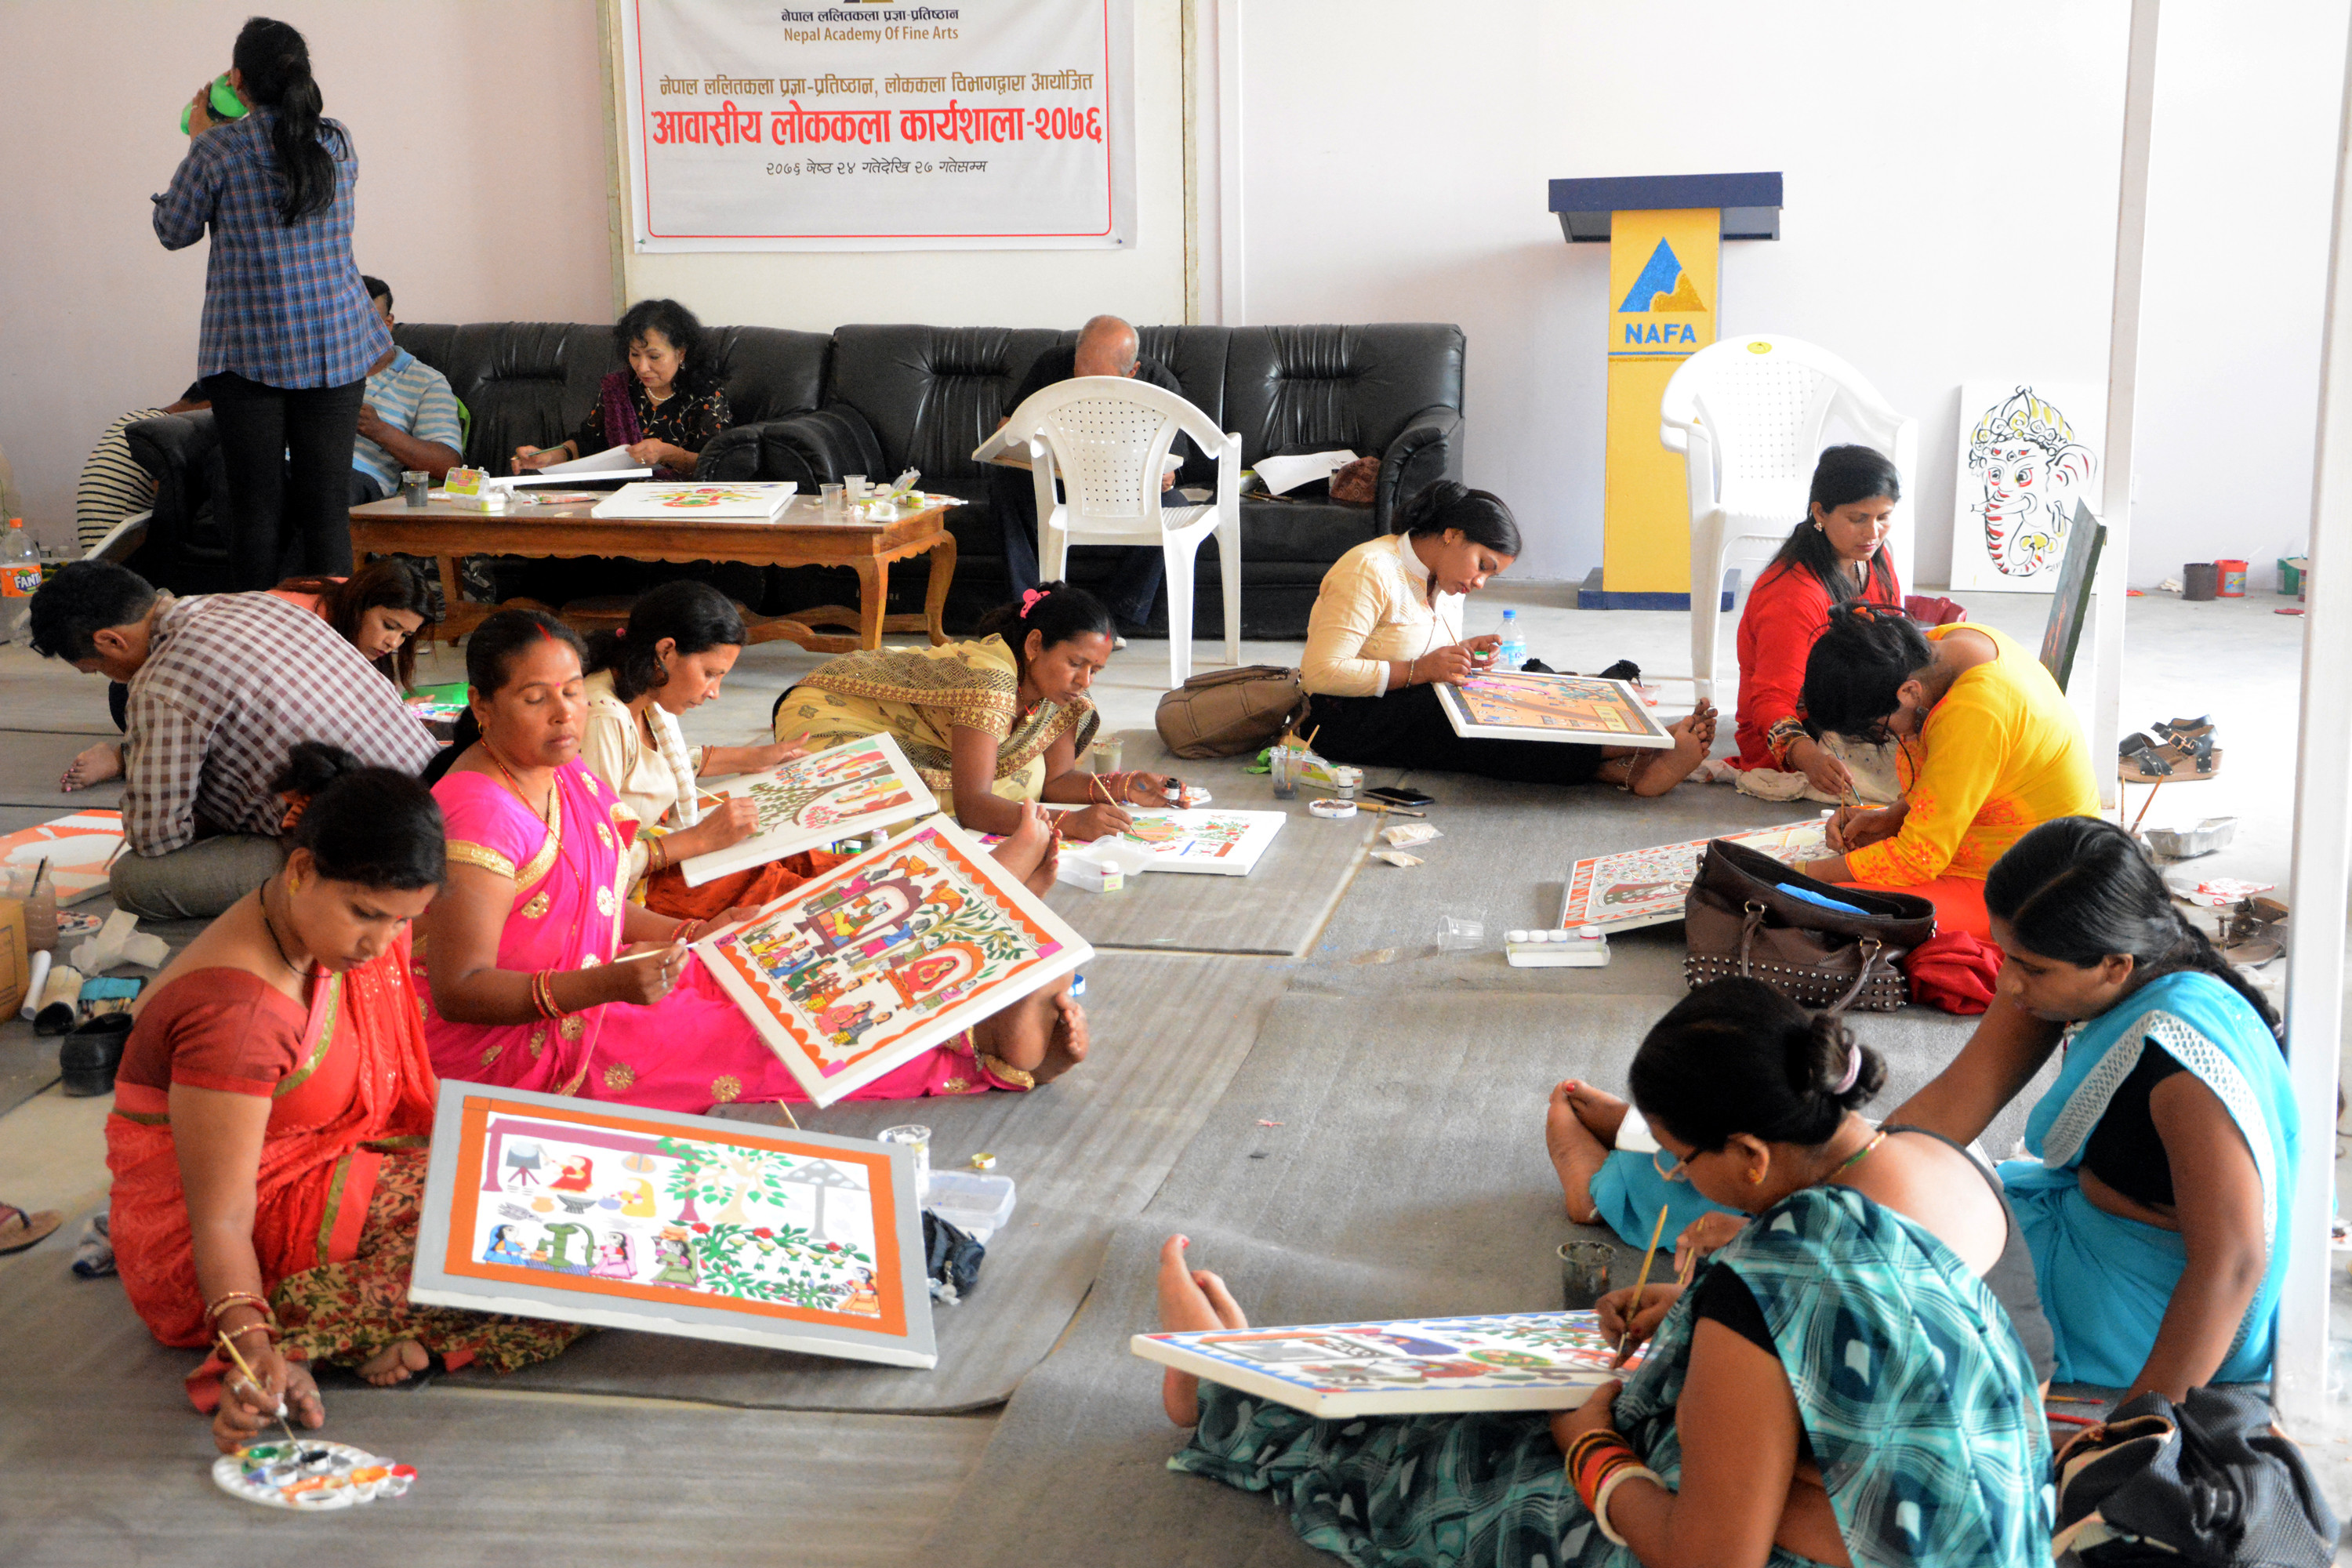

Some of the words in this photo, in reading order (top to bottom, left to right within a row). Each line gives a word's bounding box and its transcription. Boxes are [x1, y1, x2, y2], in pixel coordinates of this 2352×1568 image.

[782, 9, 814, 22] नेपाल
[818, 8, 879, 22] ललितकला
[784, 27, 820, 44] Nepal
[825, 27, 881, 44] Academy
[885, 26, 899, 40] Of
[903, 26, 929, 40] Fine
[933, 26, 959, 39] Arts
[659, 75, 699, 95] नेपाल
[705, 74, 775, 95] ललितकला
[885, 74, 946, 93] लोककला
[951, 72, 1026, 95] विभागद्वारा
[1032, 70, 1094, 92] आयोजित
[652, 100, 763, 147] आवासीय
[771, 100, 891, 145] लोककला
[766, 162, 800, 176] २०७६
[837, 162, 856, 175] २४
[862, 157, 911, 174] गतेदेखि
[914, 161, 933, 174] २७
[938, 157, 988, 173] गतेसम्म
[1625, 323, 1697, 344] NAFA
